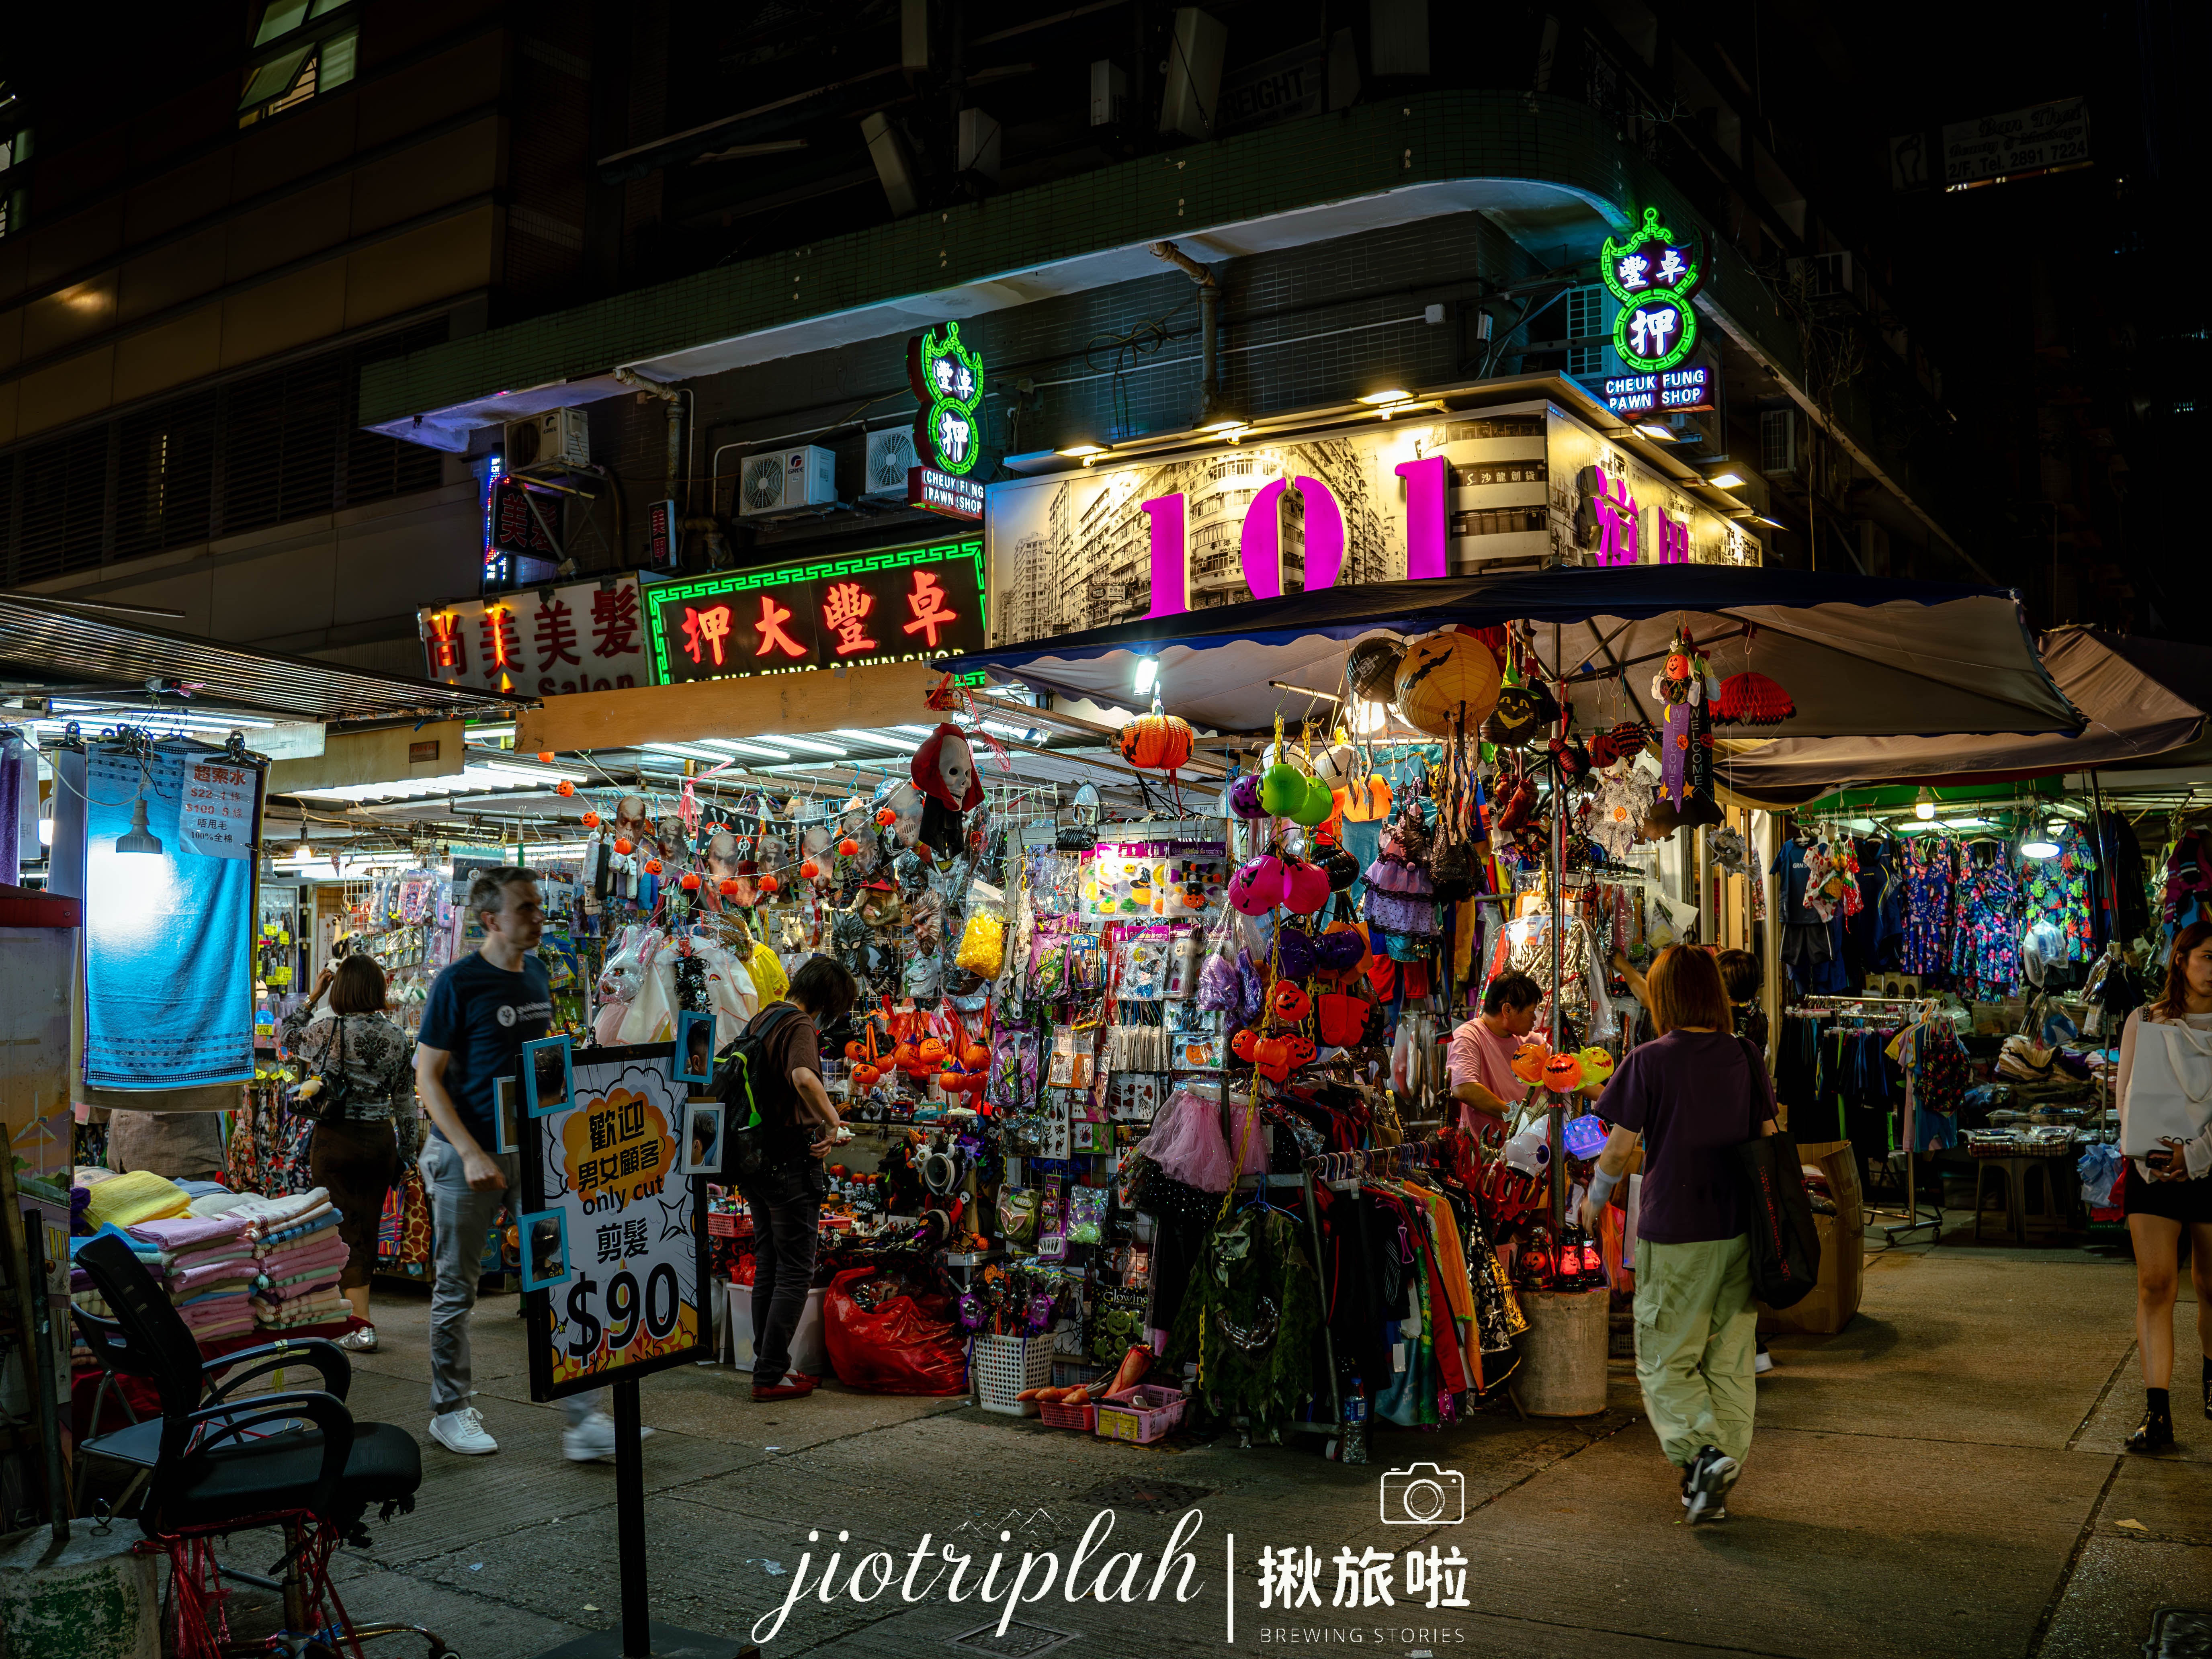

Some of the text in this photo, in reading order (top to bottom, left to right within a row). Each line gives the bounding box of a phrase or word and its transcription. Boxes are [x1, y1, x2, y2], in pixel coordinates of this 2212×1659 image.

[1949, 140, 2086, 179] 2/F, Tel. 2891 7224
[1630, 308, 1675, 355] 押
[1606, 369, 1704, 394] CHEUK FUNG
[1610, 388, 1701, 409] PAWN SHOP
[939, 412, 969, 462] 押
[788, 467, 805, 475] GREE
[925, 471, 955, 490] CHEUK
[926, 487, 981, 514] PAWN SHOP
[499, 493, 559, 554] 美髮
[652, 507, 666, 563] 美甲
[1141, 455, 1447, 619] 101
[1210, 538, 1241, 550] 香港
[426, 584, 640, 680] 尚美美髮
[1668, 709, 1682, 786] WELCOME
[1690, 708, 1703, 785] WELCOME
[191, 788, 212, 798] $22
[194, 764, 246, 786] 超索水
[186, 803, 215, 814] $100
[222, 807, 229, 816] 5
[198, 818, 227, 830] 唔甩毛
[589, 1100, 645, 1153] 歡迎
[578, 1140, 660, 1193] 男女顧客
[583, 1174, 664, 1216] only cut
[596, 1218, 649, 1264] 剪髮
[566, 1262, 681, 1368] $90
[1103, 1288, 1148, 1308] Glowing
